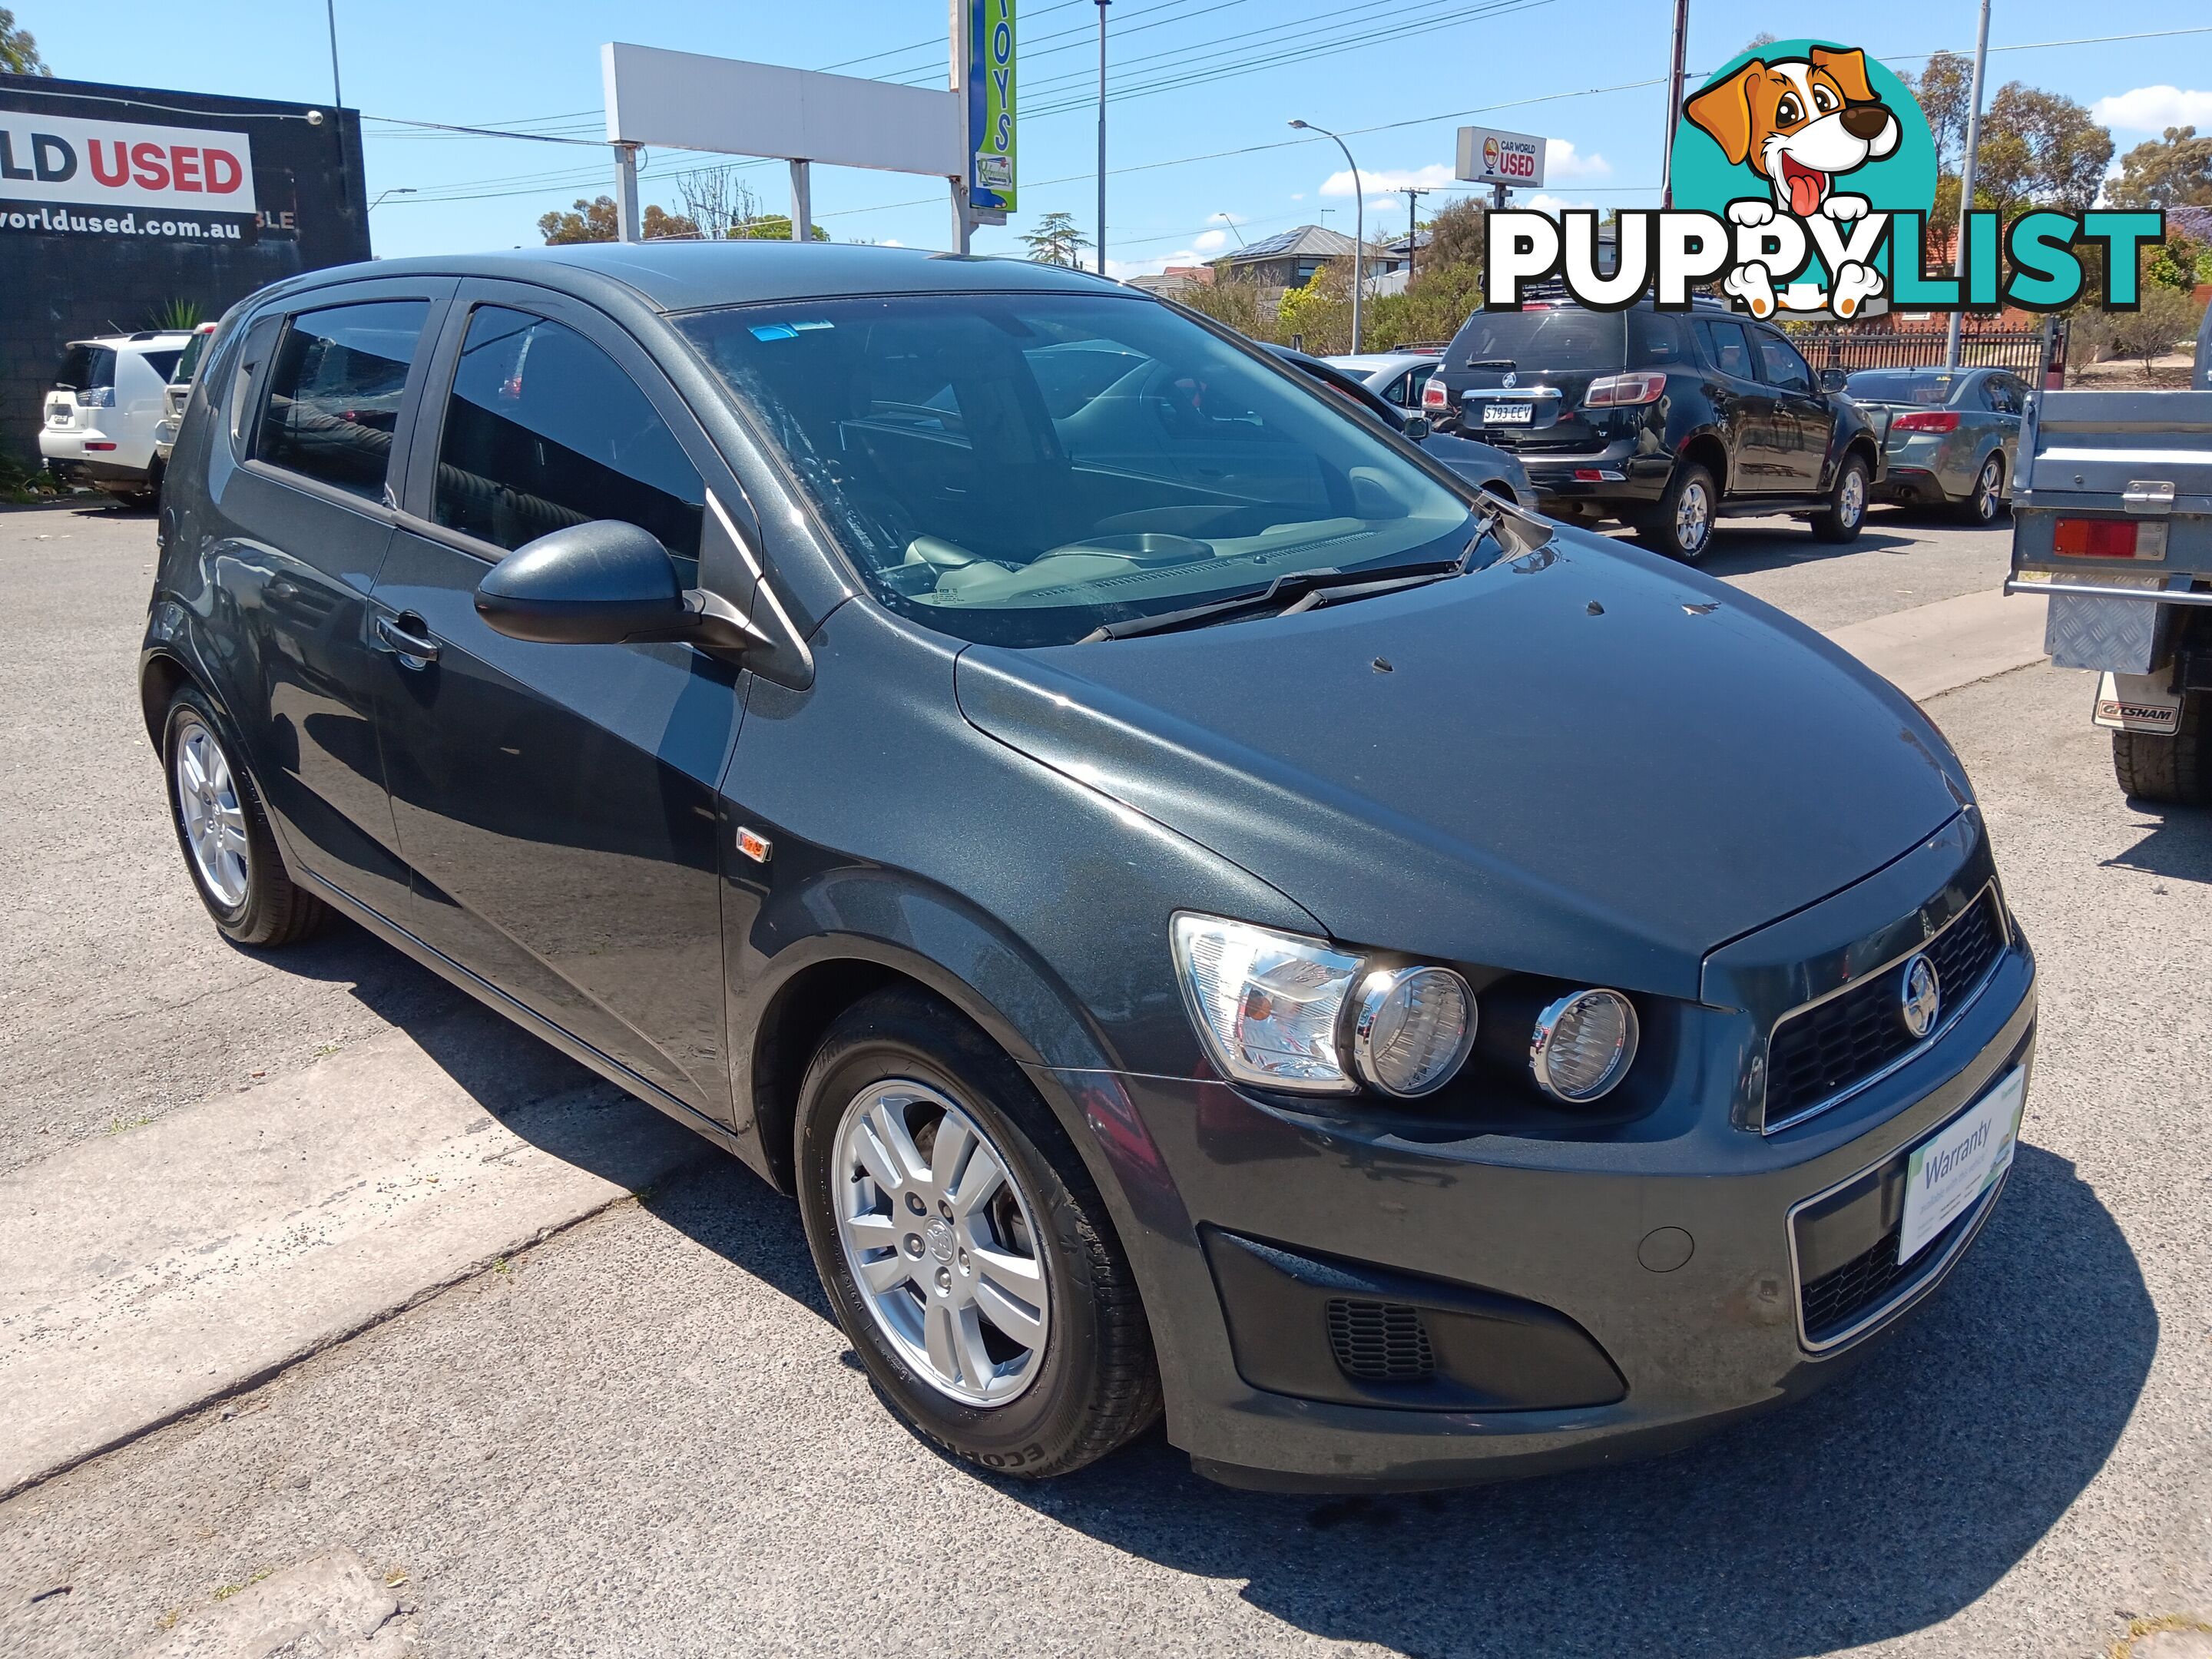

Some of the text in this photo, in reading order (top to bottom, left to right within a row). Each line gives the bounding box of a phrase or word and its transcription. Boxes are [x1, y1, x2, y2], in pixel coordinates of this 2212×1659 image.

[88, 138, 243, 194] USED
[1500, 152, 1535, 177] USED
[1501, 141, 1535, 154] CAR WORLD
[1926, 1118, 1992, 1190] Warranty
